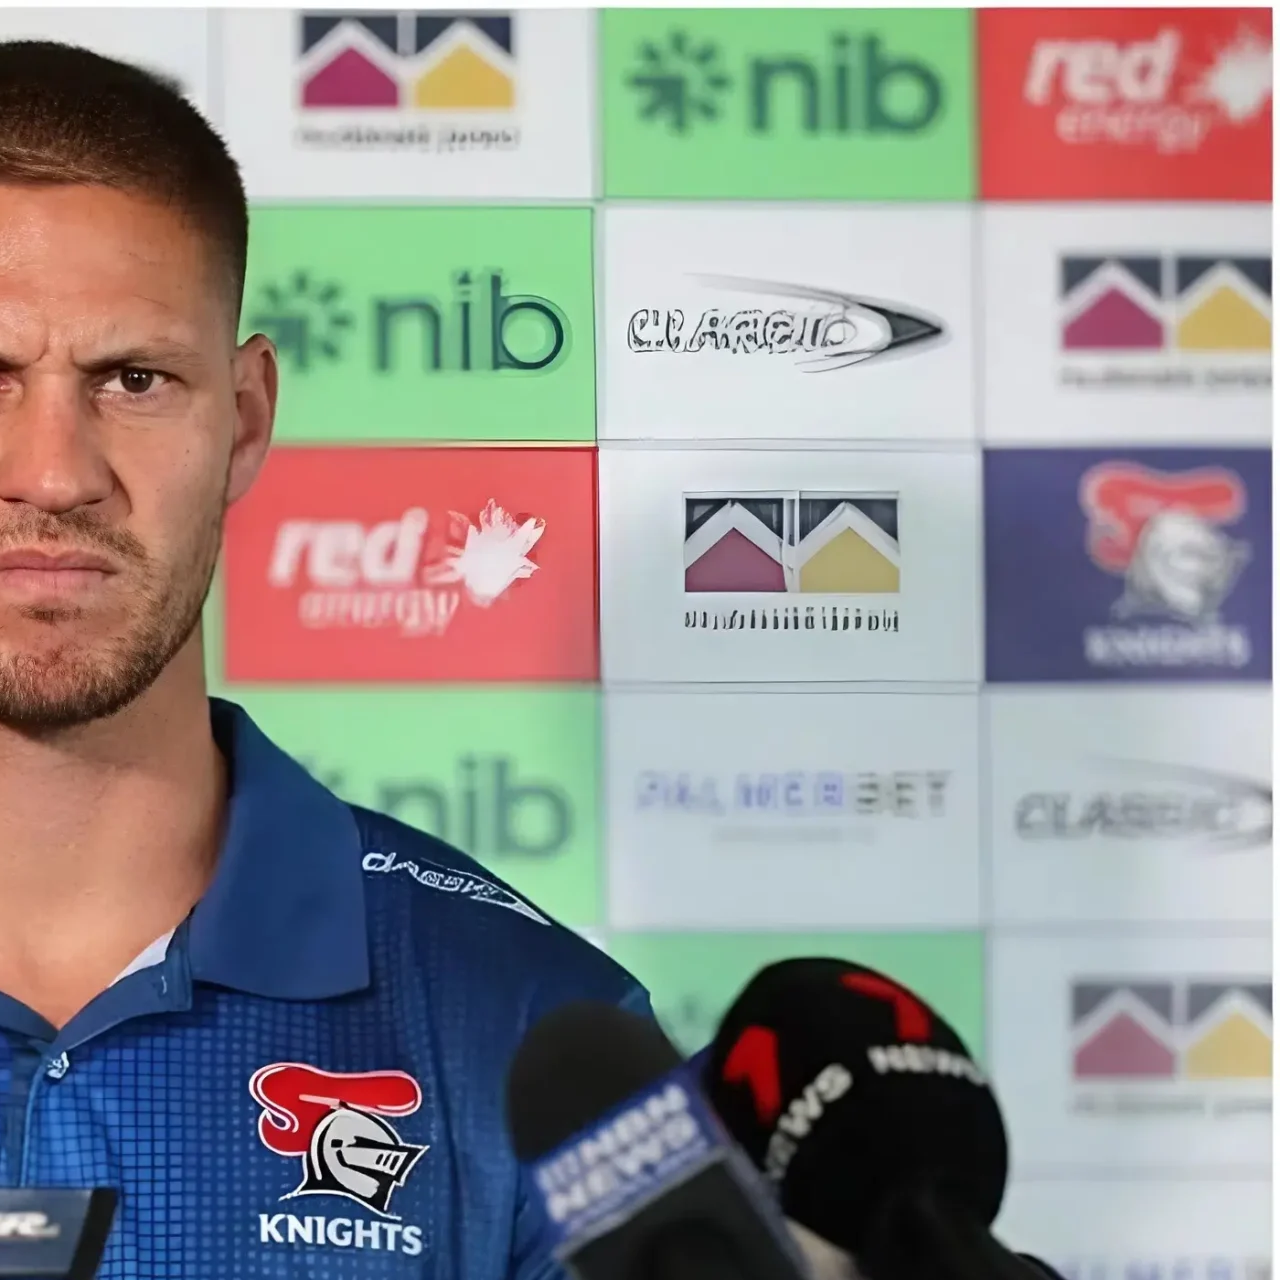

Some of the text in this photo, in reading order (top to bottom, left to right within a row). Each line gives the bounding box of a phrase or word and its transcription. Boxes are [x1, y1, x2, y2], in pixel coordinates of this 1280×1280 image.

[748, 33, 944, 134] nib
[1024, 28, 1180, 106] red
[373, 267, 567, 372] nib
[269, 508, 428, 586] red
[259, 1212, 423, 1255] KNIGHTS
